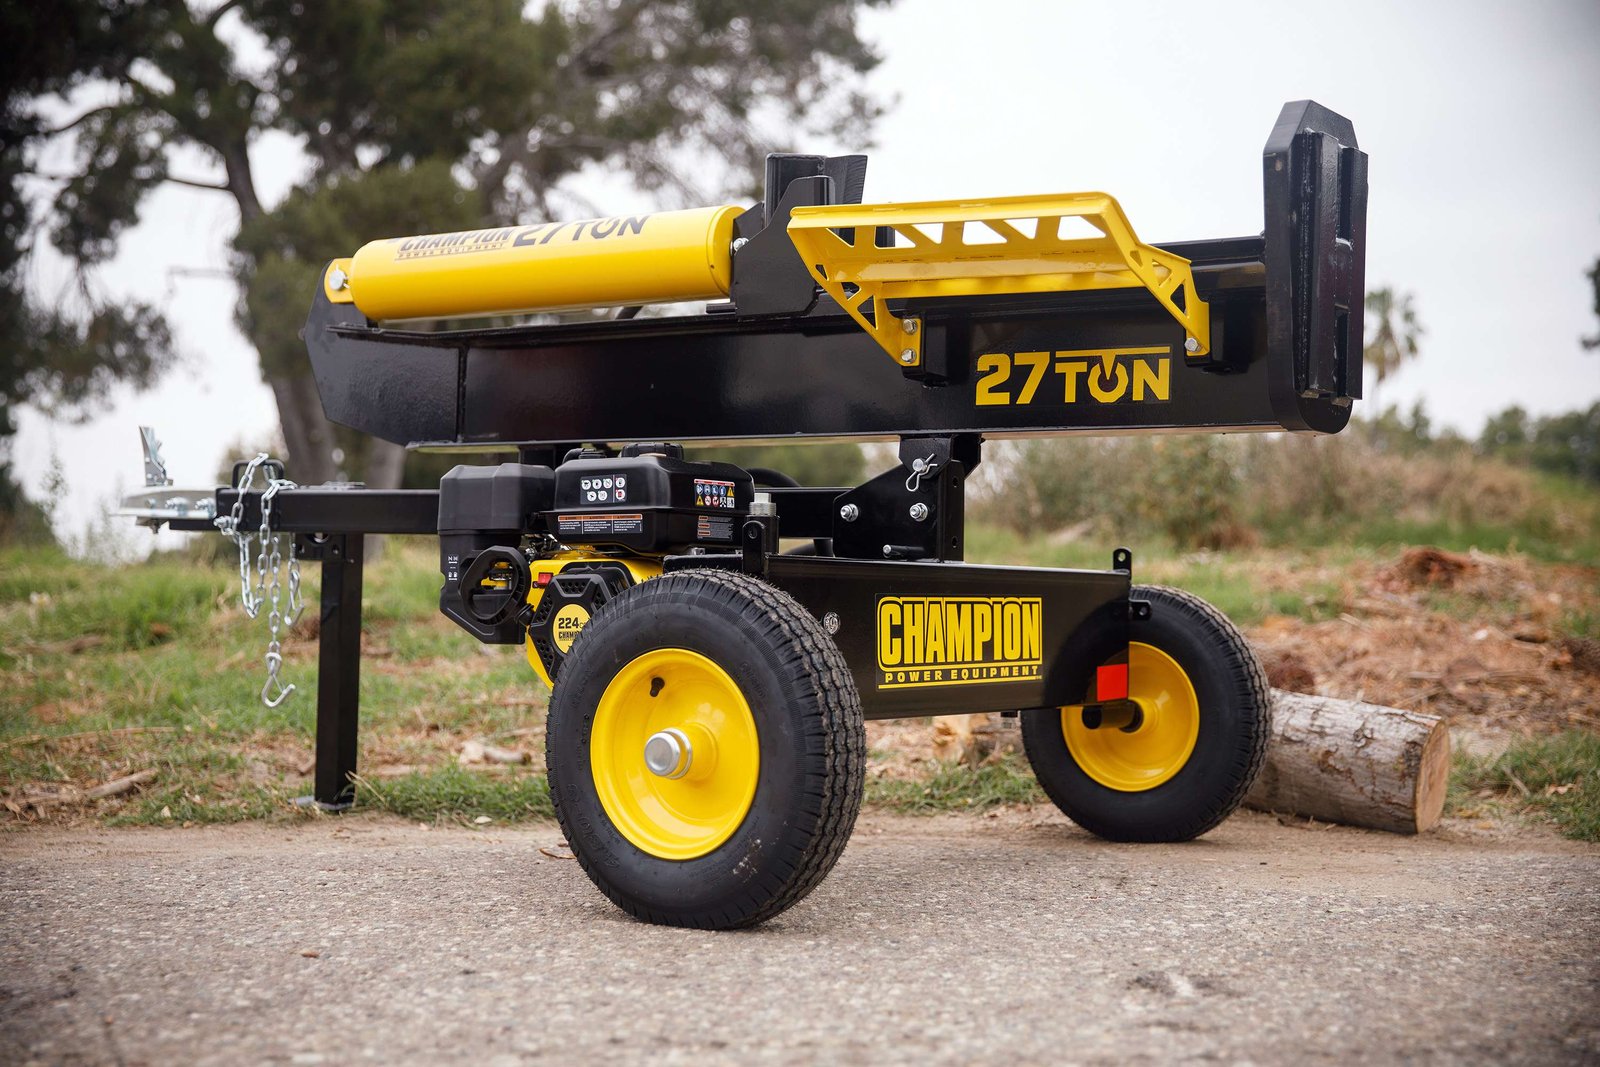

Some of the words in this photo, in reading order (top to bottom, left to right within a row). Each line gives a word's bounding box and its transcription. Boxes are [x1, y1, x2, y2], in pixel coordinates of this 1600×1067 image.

[399, 249, 434, 258] POWER
[440, 243, 504, 255] EQUIPMENT
[400, 228, 515, 252] CHAMPION
[975, 351, 1051, 406] 27
[1054, 355, 1171, 404] TON
[878, 599, 1042, 667] CHAMPION
[885, 670, 943, 683] POWER
[950, 666, 1039, 681] EQUIPMENT
